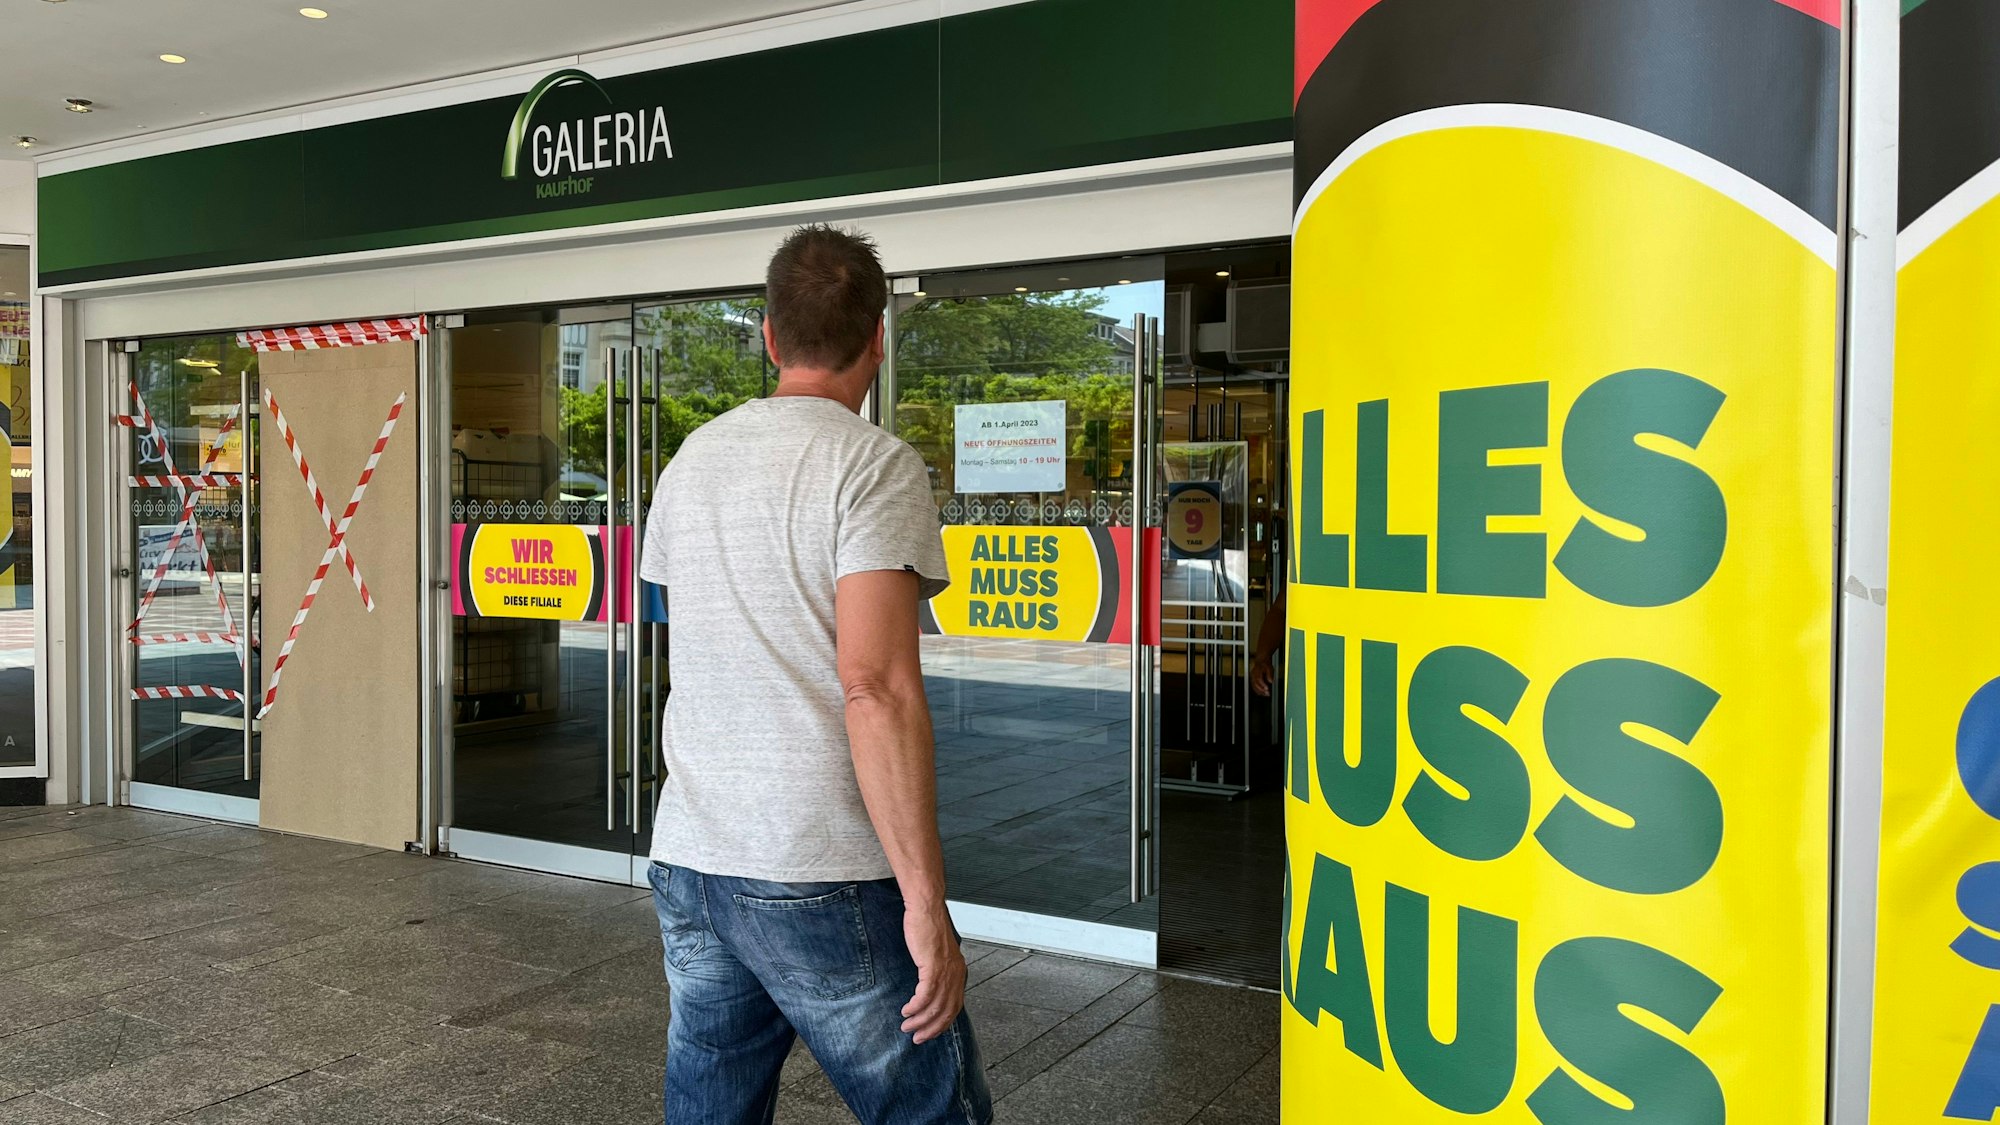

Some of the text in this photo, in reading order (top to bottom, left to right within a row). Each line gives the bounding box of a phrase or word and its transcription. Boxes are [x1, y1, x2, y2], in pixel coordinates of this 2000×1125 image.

[532, 106, 673, 177] GALERIA
[1020, 419, 1038, 427] 2023
[964, 437, 1056, 448] NEUE ÖFFNUNGSZEITEN
[960, 459, 983, 467] Montag
[990, 458, 1017, 466] Samstag
[1046, 456, 1061, 464] Uhr
[1289, 368, 1727, 607] LLES
[1184, 508, 1204, 534] 9
[511, 538, 554, 564] WIR
[970, 535, 1059, 563] ALLES
[484, 566, 577, 586] SCHLIESSEN
[970, 567, 1059, 597] MUSS
[503, 595, 562, 608] DIESE FILIALE
[969, 600, 1059, 630] RAUS
[1282, 840, 1726, 1125] AUS
